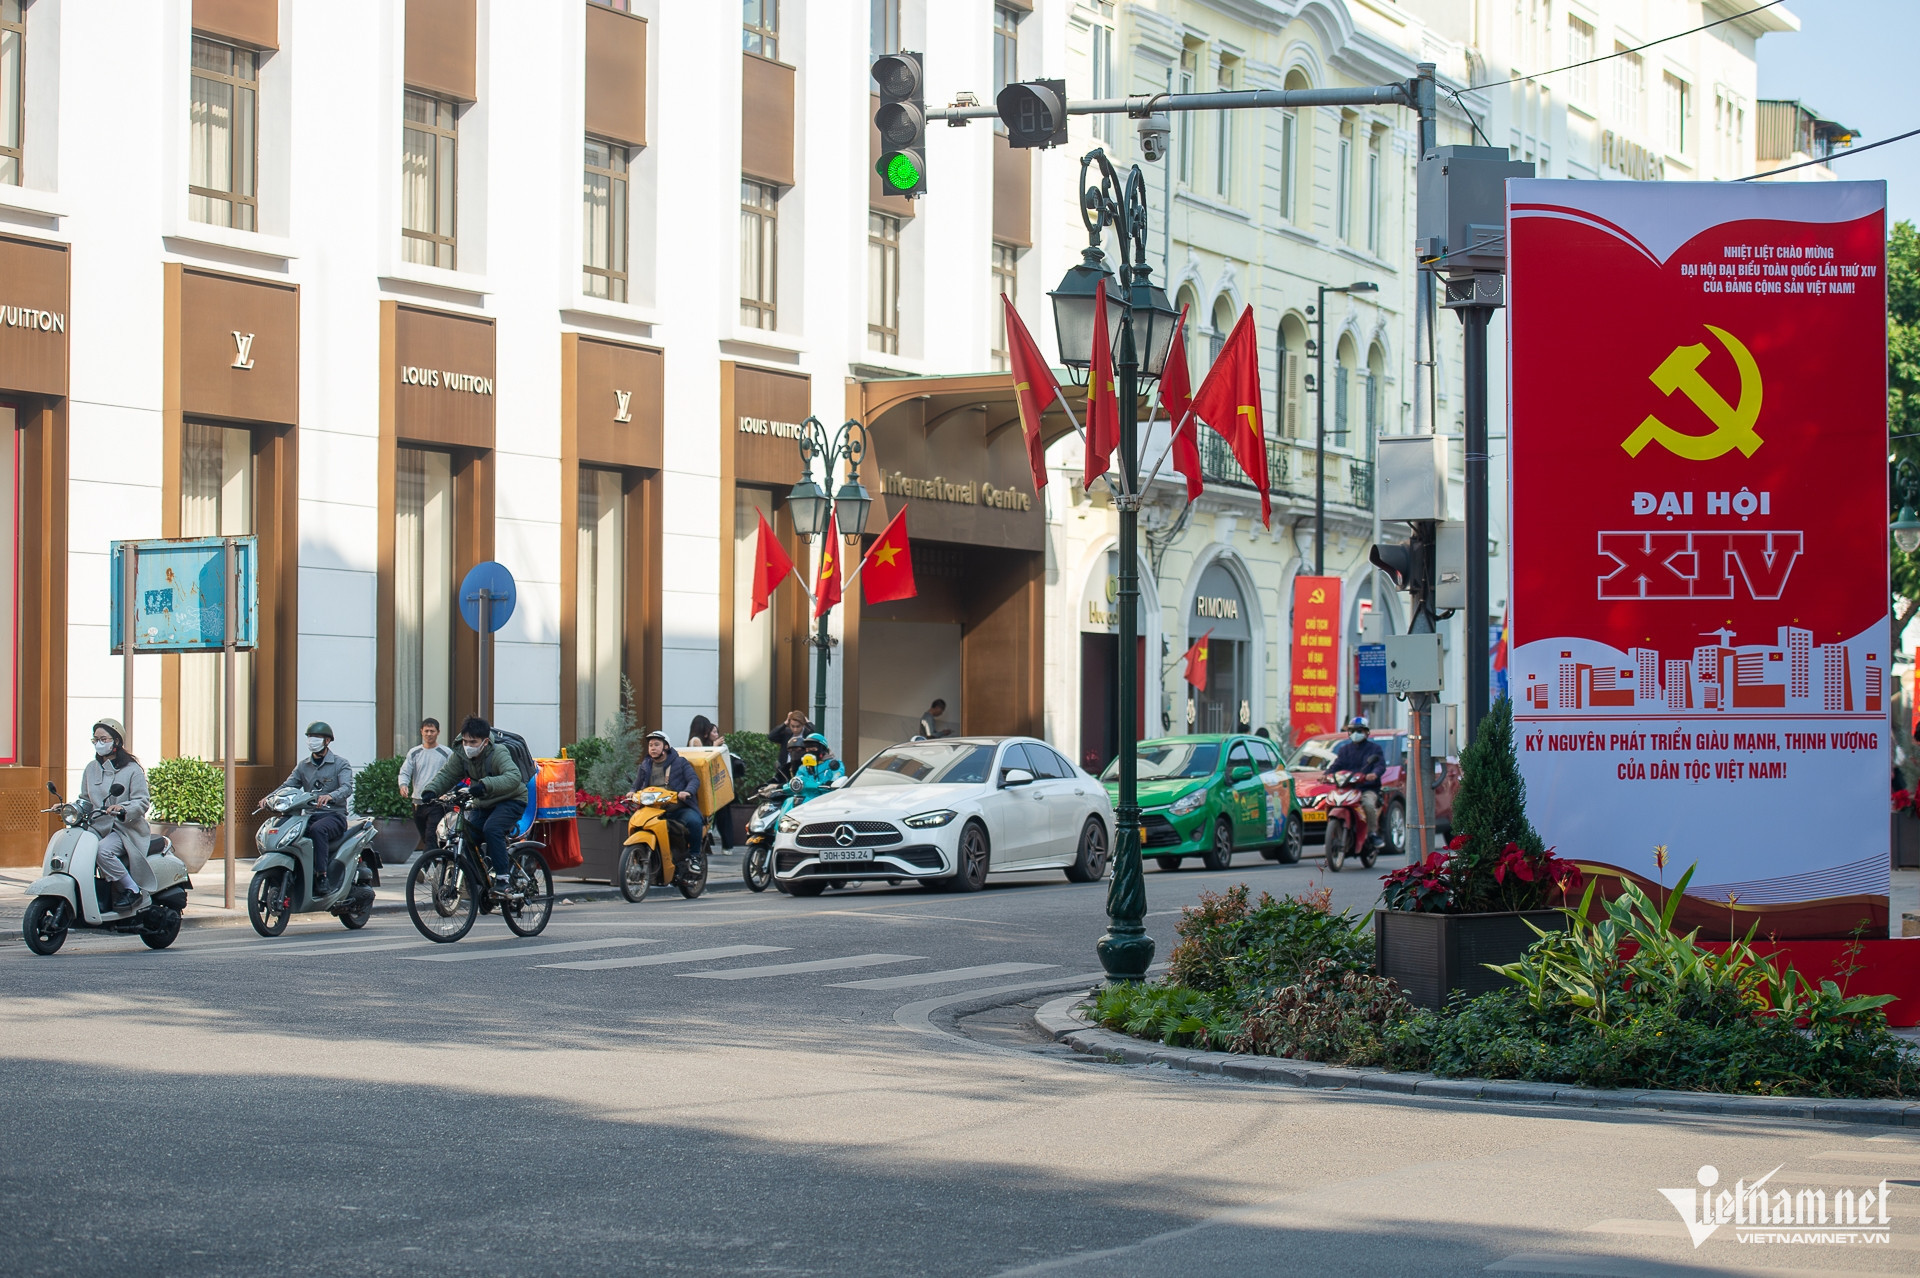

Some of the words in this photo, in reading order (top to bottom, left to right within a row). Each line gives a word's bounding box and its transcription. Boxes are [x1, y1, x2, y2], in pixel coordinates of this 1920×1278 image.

[1724, 244, 1752, 260] NHIỆT
[1754, 244, 1775, 260] LIỆT
[1776, 245, 1802, 259] CHÀO
[1805, 245, 1834, 259] MỪNG
[1681, 264, 1698, 278] ĐẠI
[1701, 262, 1717, 278] HỘI
[1719, 264, 1736, 278] ĐẠI
[1738, 260, 1761, 276] BIỂU
[1763, 262, 1788, 277] TOÀN
[1790, 261, 1817, 277] QUỐC
[1819, 261, 1838, 277] LẦN
[1840, 262, 1860, 277] THỨ
[1861, 265, 1877, 277] XIV
[1703, 277, 1723, 293] CỦA
[1725, 278, 1752, 293] ĐẢNG
[1755, 279, 1781, 295] CỘNG
[1784, 278, 1804, 294] SẢN
[1806, 279, 1826, 295] VIỆT
[1829, 282, 1855, 294] NAM!
[402, 366, 439, 387] LOUIS
[442, 371, 493, 395] VUITTON
[739, 416, 768, 436] LOUIS
[880, 468, 978, 505] International
[981, 481, 1031, 512] Centre
[1631, 491, 1693, 522] ĐẠI
[1707, 486, 1771, 522] HỘI
[1597, 530, 1804, 600] XIV
[1196, 595, 1239, 619] RIMOWA
[1526, 729, 1544, 752] KỶ
[1548, 730, 1606, 752] NGUYÊN
[1610, 730, 1647, 751] PHÁT
[1650, 726, 1691, 751] TRIỂN
[1696, 730, 1729, 751] GIÀU
[1733, 732, 1781, 754] MẠNH,
[1784, 732, 1826, 754] THỊNH
[1831, 731, 1878, 754] VƯỢNG
[1617, 757, 1646, 780] CỦA
[1650, 759, 1680, 780] DÂN
[1684, 759, 1711, 783] TỘC
[1714, 758, 1745, 783] VIỆT
[1748, 762, 1787, 779] NAM!
[823, 850, 868, 860] 30H-939.24
